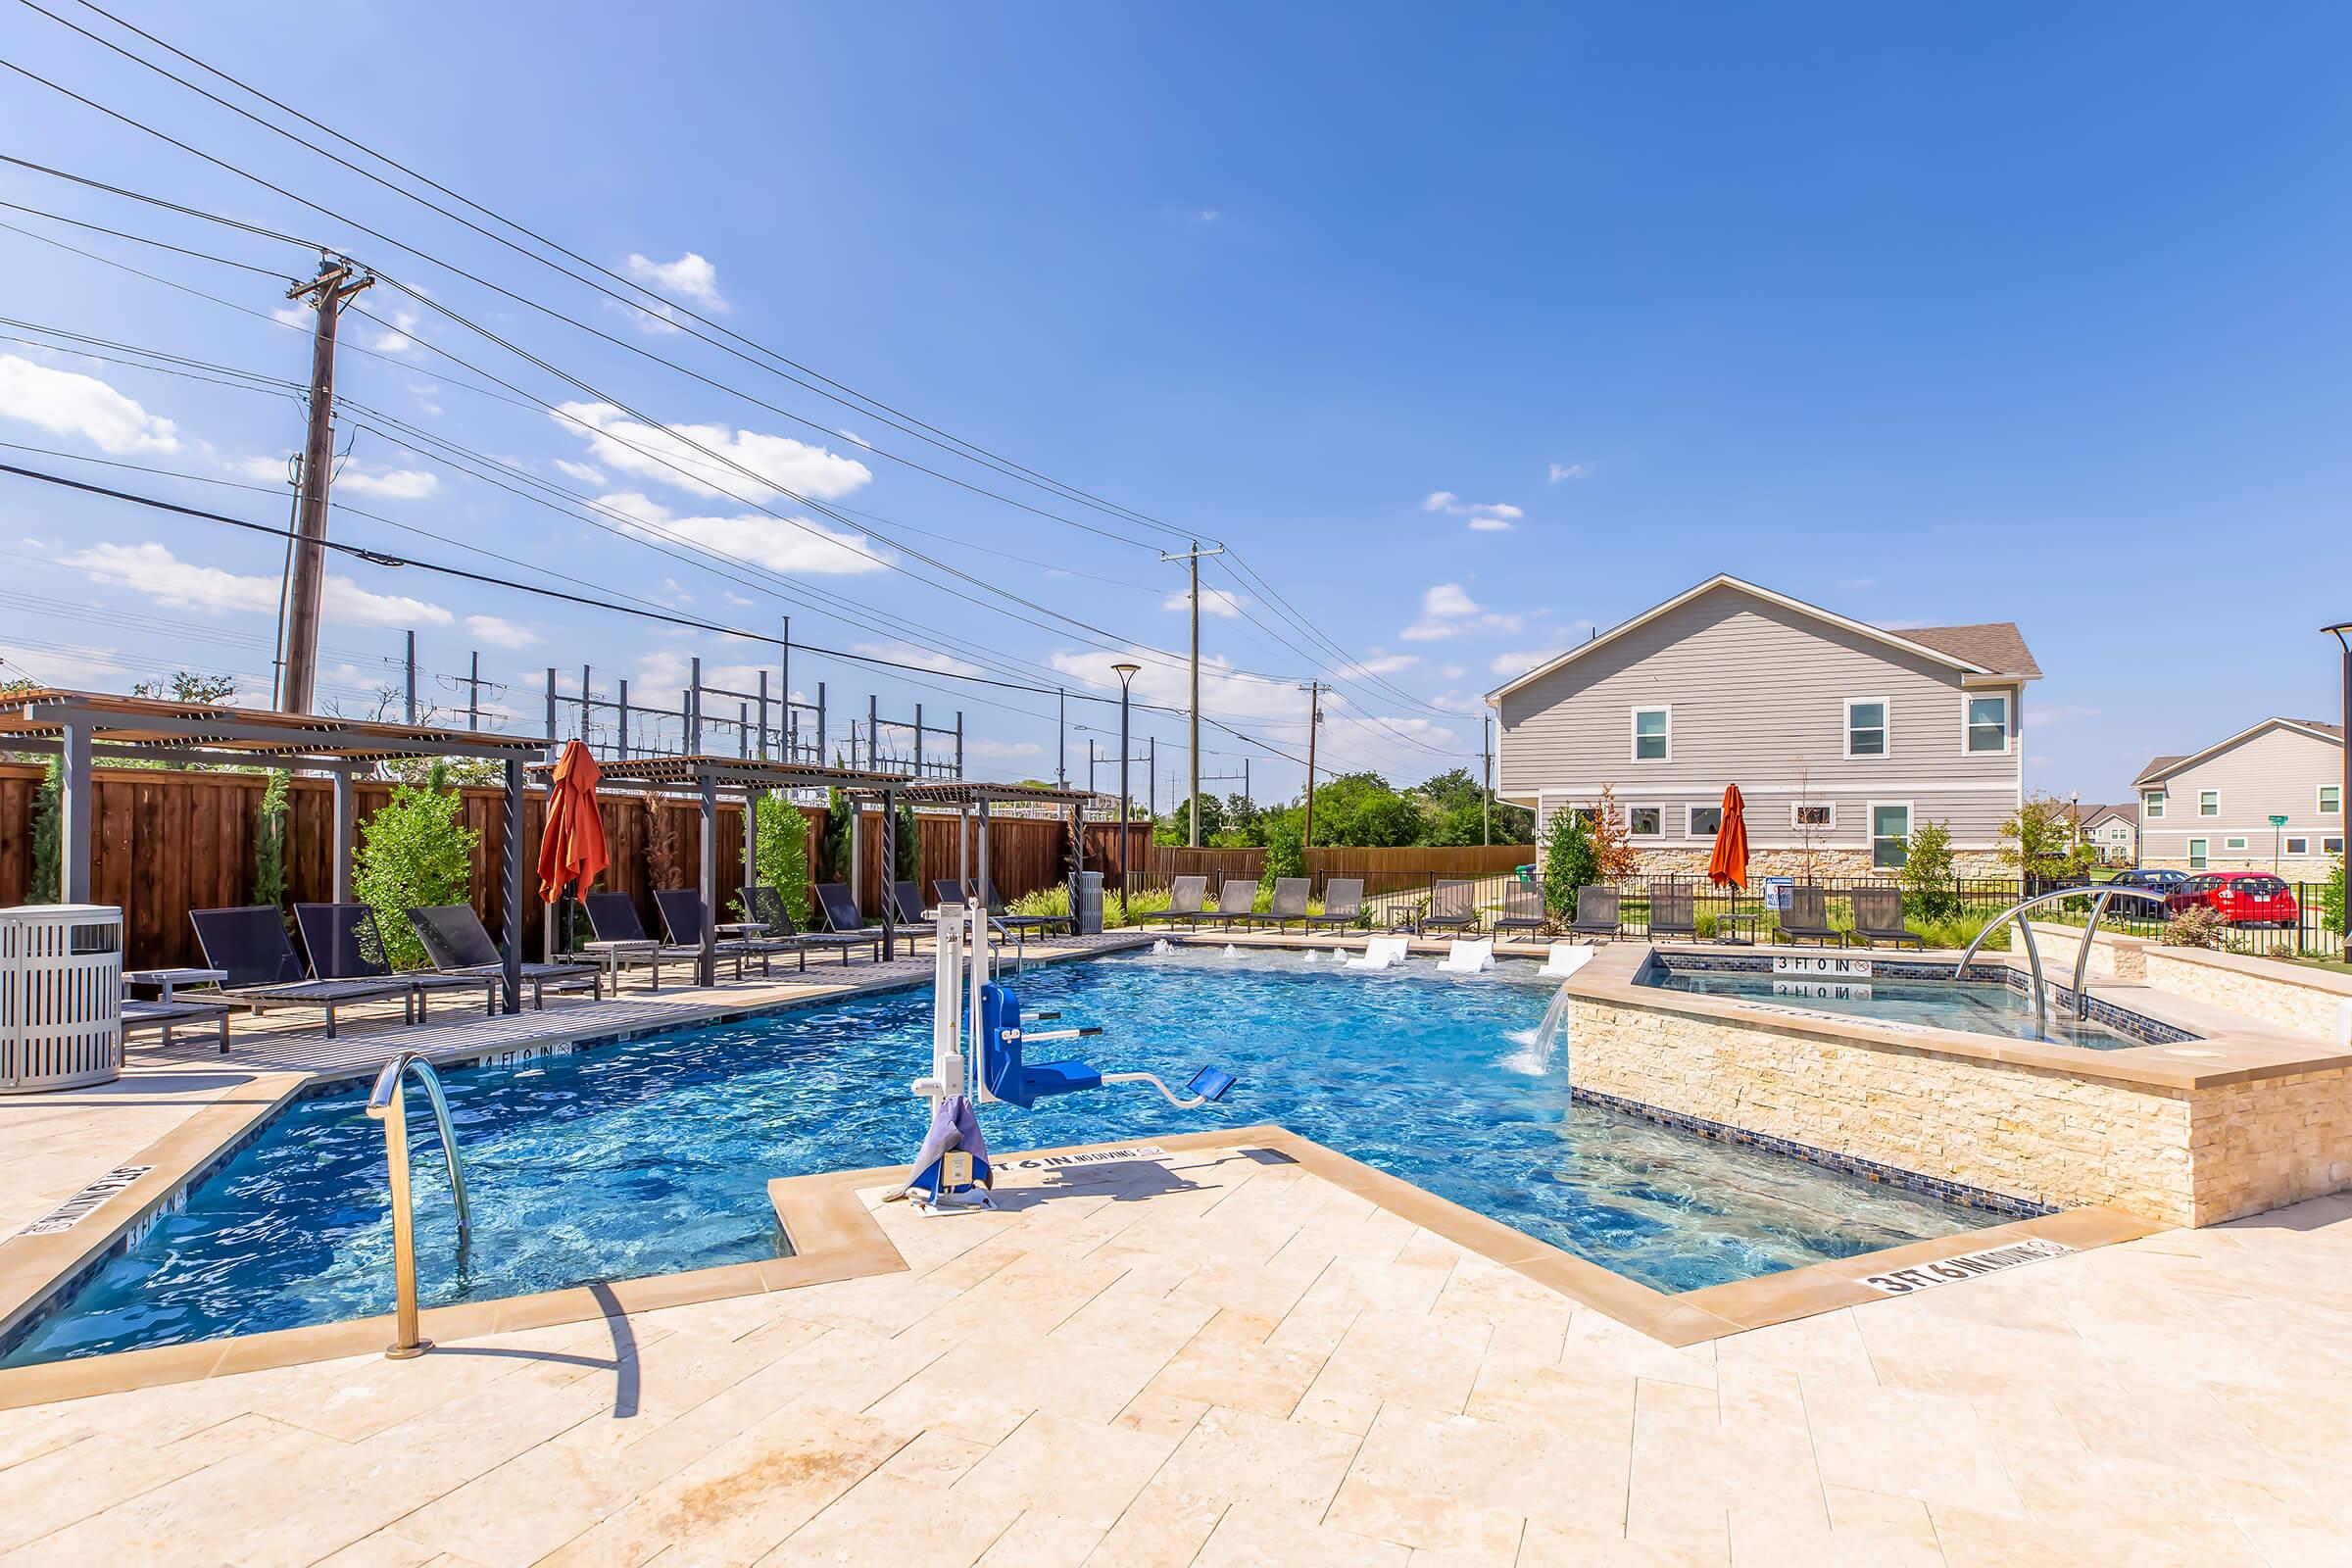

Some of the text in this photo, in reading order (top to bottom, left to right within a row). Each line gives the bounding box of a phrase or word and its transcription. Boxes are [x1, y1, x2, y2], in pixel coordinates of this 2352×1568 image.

[1779, 956, 1787, 968] 3
[1795, 957, 1809, 969] FT
[1836, 958, 1849, 971] IN
[502, 1051, 516, 1066] FT
[540, 1046, 553, 1055] IN
[1019, 1159, 1042, 1168] 6
[1092, 1151, 1136, 1160] DIVING
[1867, 1277, 1913, 1293] 3
[1928, 1264, 1969, 1278] 6
